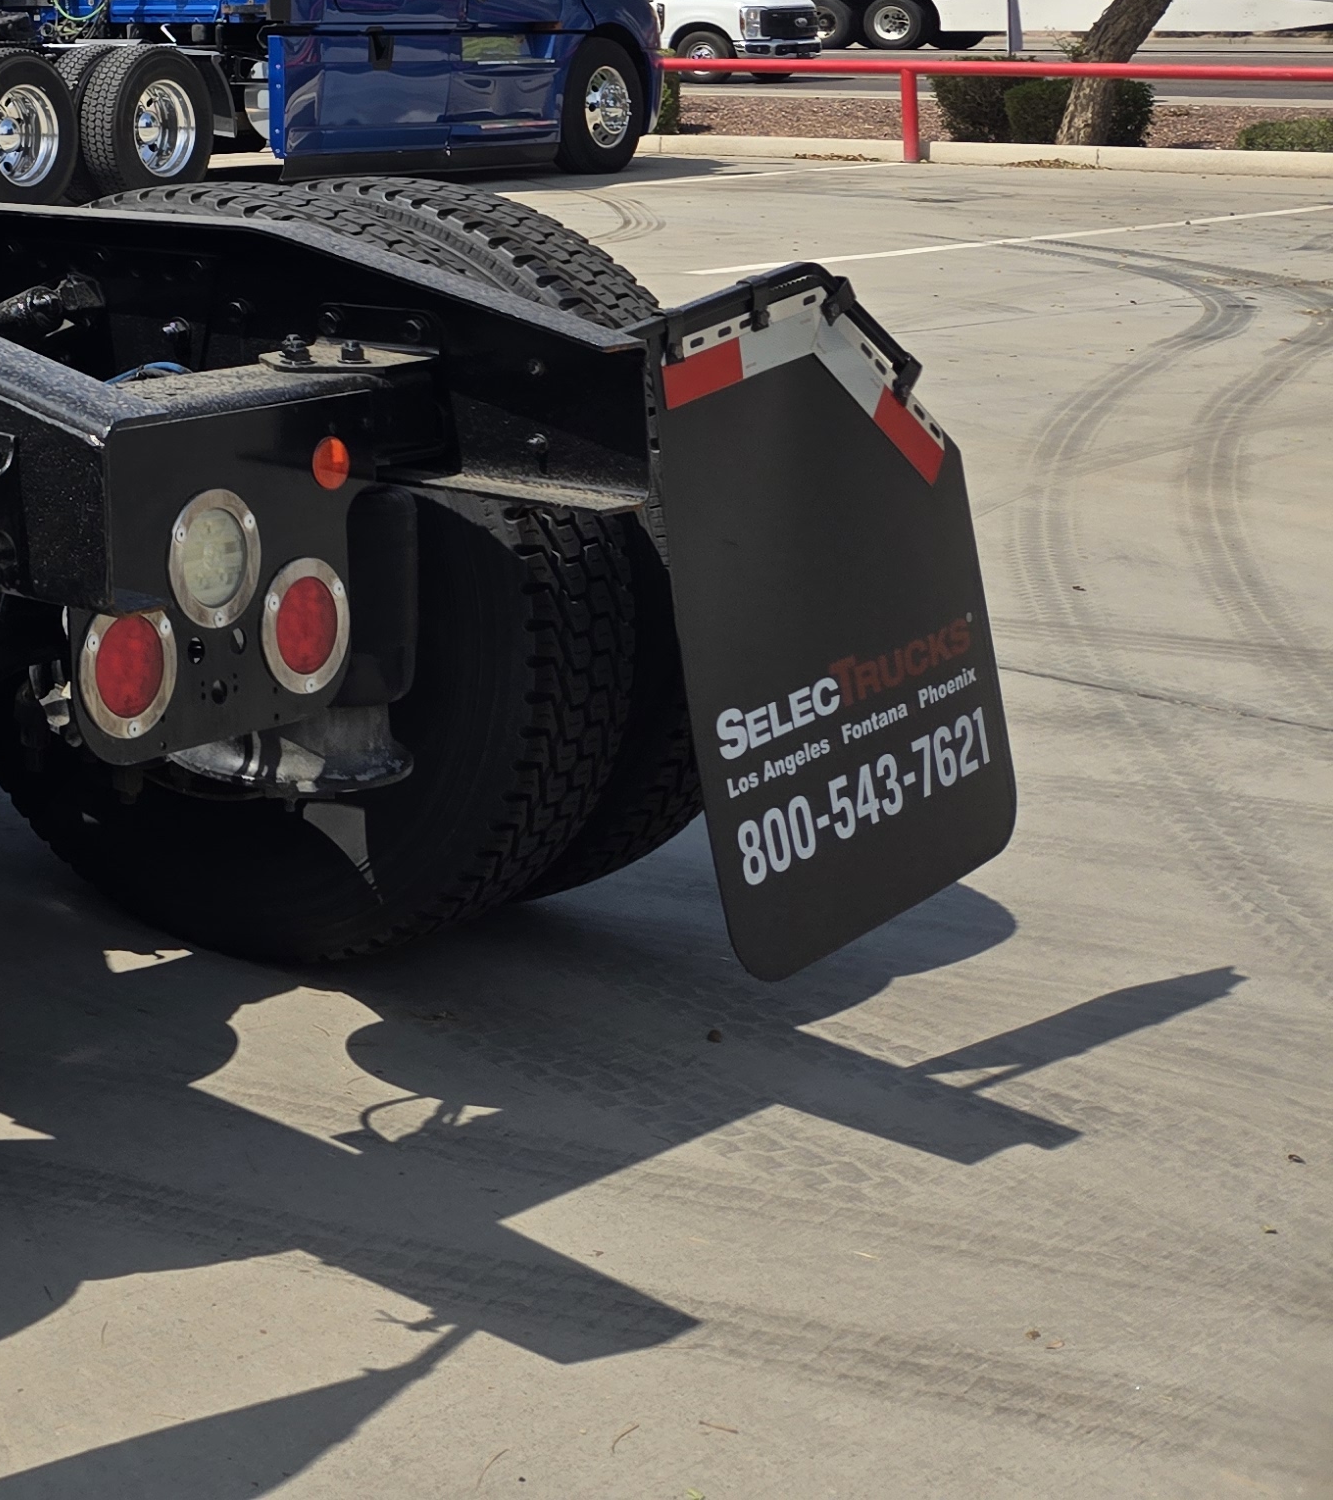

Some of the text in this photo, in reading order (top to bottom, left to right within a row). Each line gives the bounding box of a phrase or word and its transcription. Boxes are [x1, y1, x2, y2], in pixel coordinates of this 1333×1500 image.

[726, 666, 977, 798] Los Angeles Fontana Phoenix
[737, 706, 991, 886] 800-543-7621
